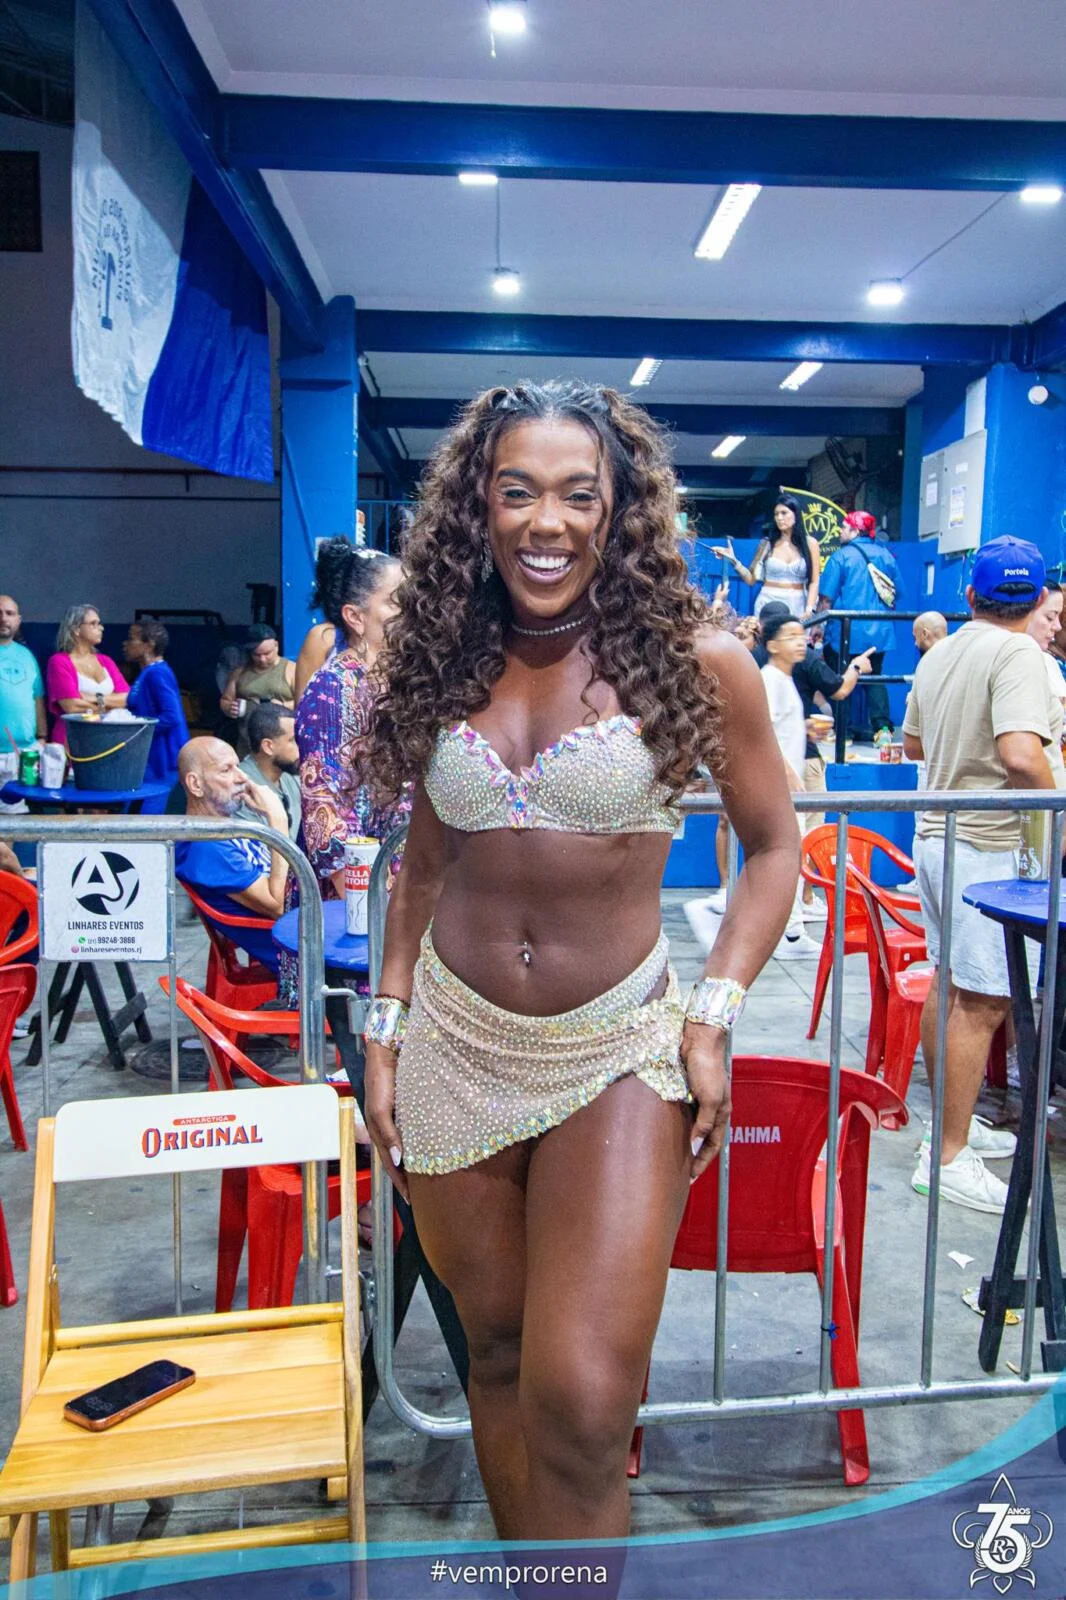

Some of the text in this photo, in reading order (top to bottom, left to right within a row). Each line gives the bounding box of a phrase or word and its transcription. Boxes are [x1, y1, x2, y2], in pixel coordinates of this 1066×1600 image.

[1004, 568, 1029, 576] Portela
[67, 921, 144, 930] LINHARES EVENTOS
[180, 1115, 229, 1125] ANTARCTICA
[141, 1124, 264, 1158] ORIGINAL
